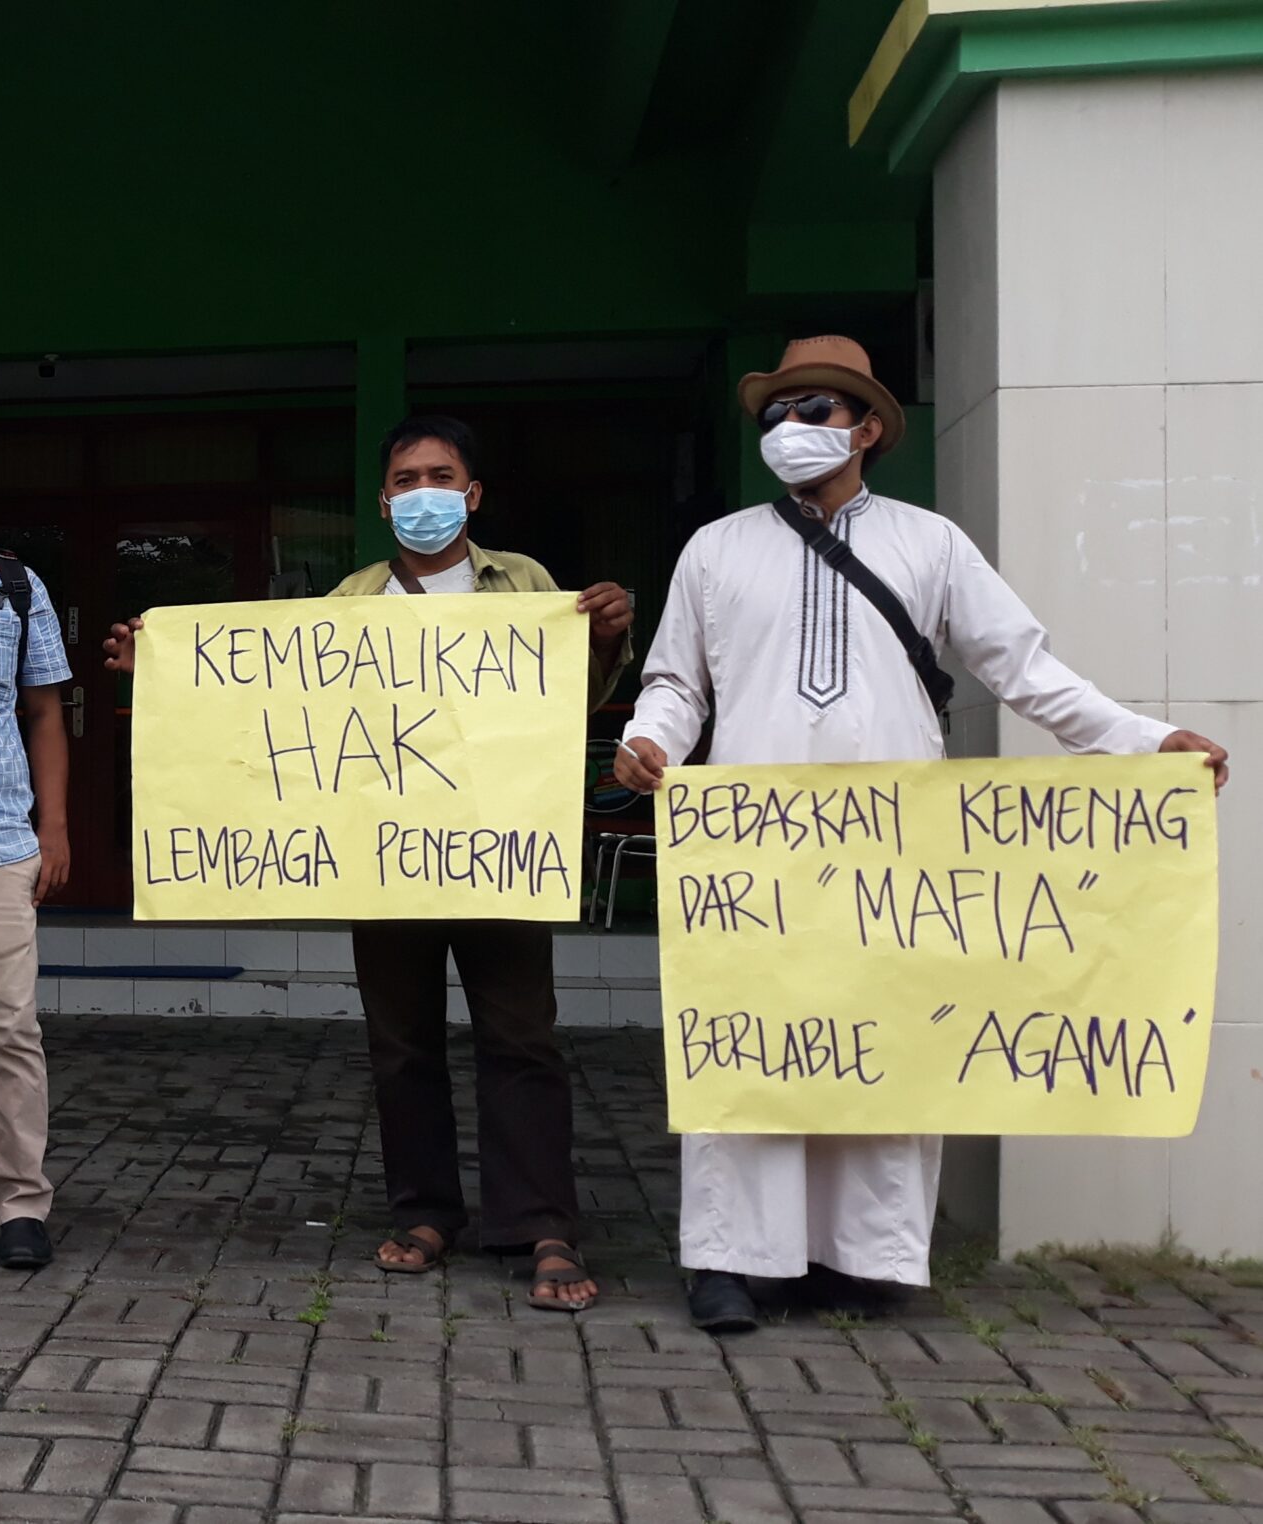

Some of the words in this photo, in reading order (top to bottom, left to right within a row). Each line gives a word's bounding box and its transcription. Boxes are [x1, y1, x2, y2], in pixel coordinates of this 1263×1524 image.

[195, 621, 545, 697] KEMBALIKAN
[263, 704, 457, 801] HAK
[668, 782, 902, 856] BEBASKAN
[960, 781, 1197, 854] KEMENAG
[144, 825, 338, 890] LEMBAGA
[376, 822, 570, 899] PENERIMA
[679, 871, 785, 935] DARI
[678, 1008, 884, 1085] BERLABLE
